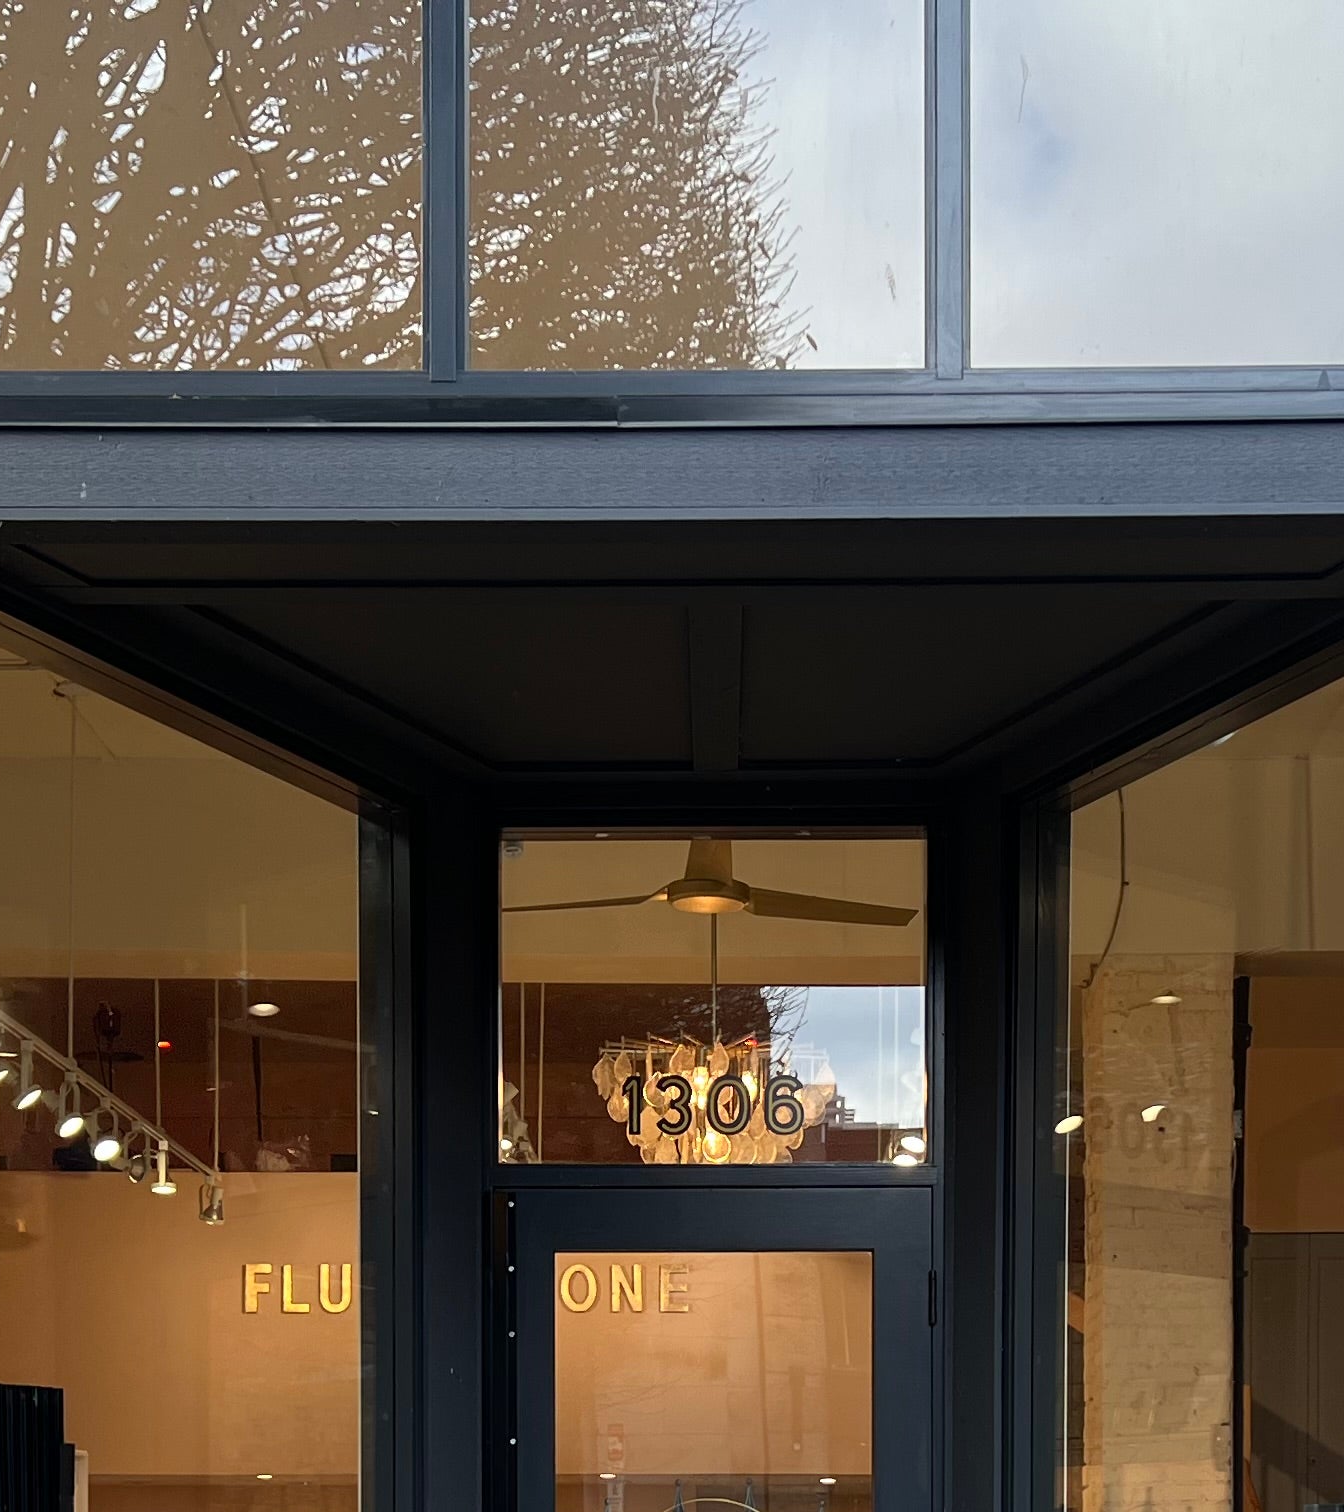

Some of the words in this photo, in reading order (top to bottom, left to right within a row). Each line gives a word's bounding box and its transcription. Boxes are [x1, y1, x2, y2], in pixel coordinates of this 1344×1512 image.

[621, 1074, 805, 1136] 1306
[242, 1263, 353, 1314] FLU
[559, 1263, 690, 1313] ONE
